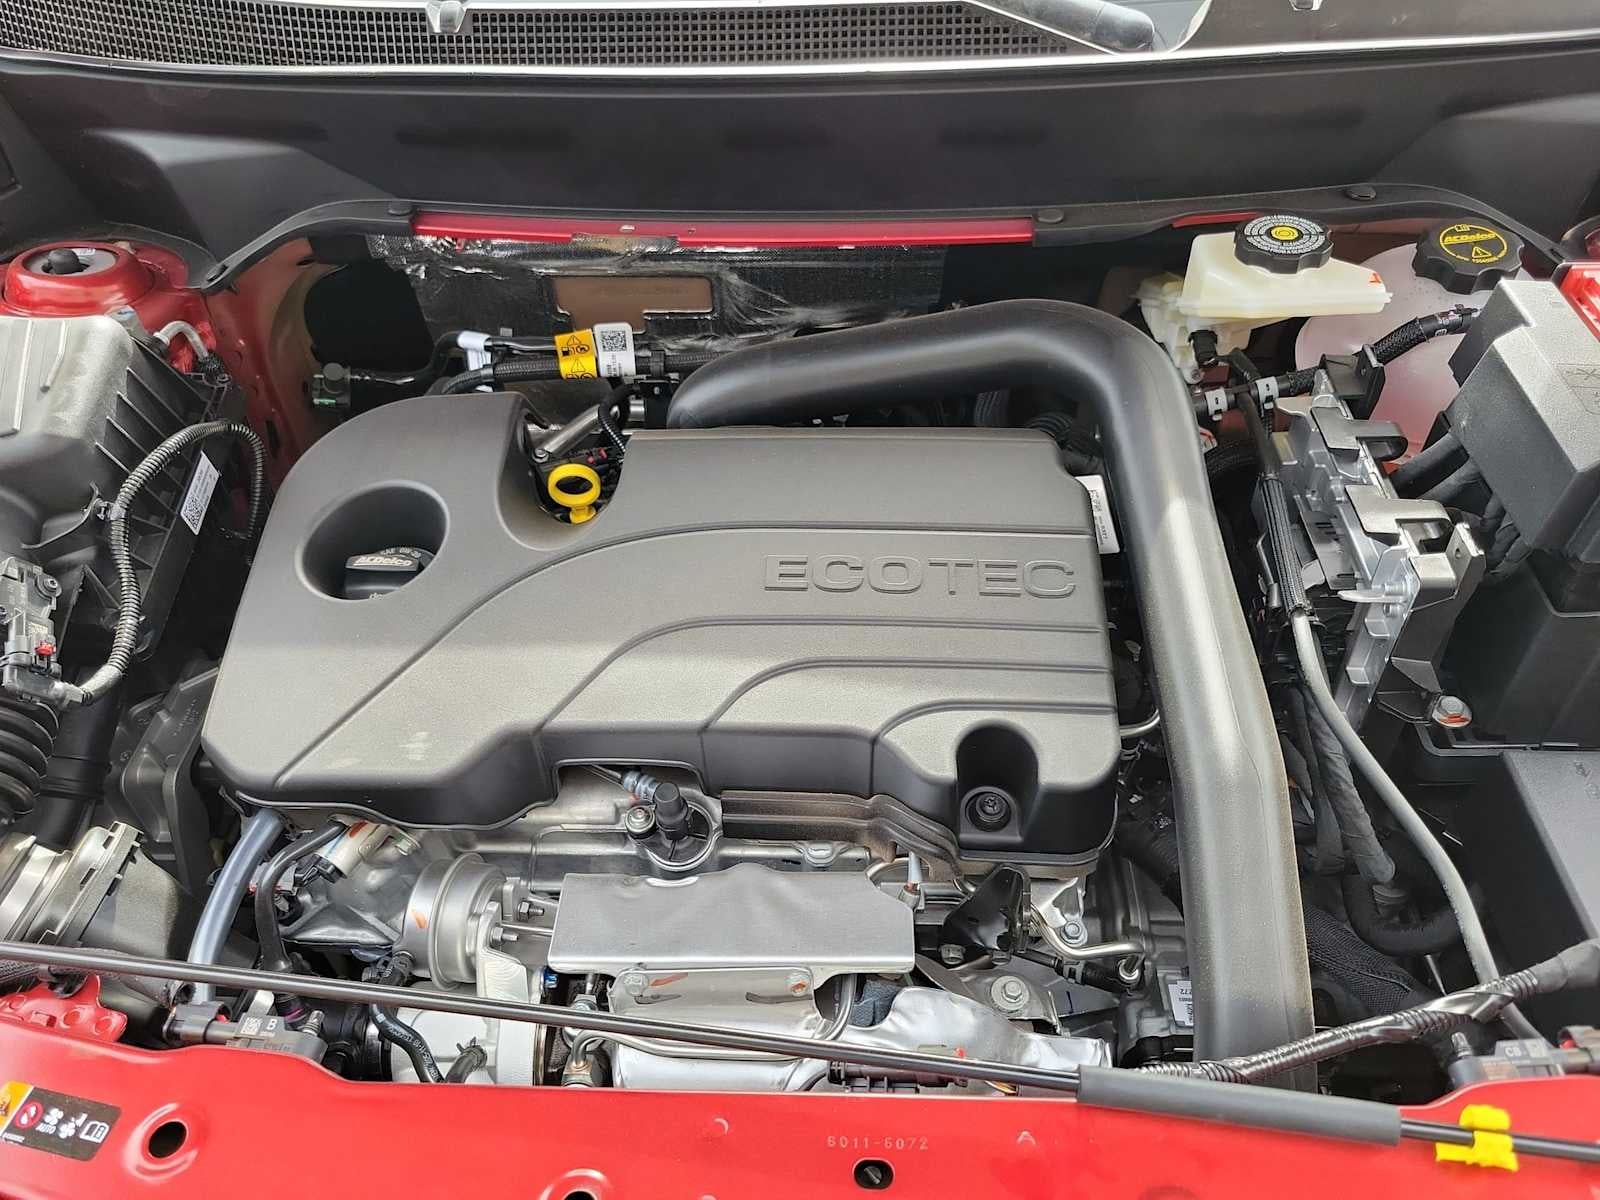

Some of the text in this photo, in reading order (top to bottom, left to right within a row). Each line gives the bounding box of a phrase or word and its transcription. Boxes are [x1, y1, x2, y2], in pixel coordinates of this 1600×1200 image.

[353, 556, 413, 567] ACDelco
[763, 553, 1077, 599] ECOTEC
[266, 1018, 278, 1031] B
